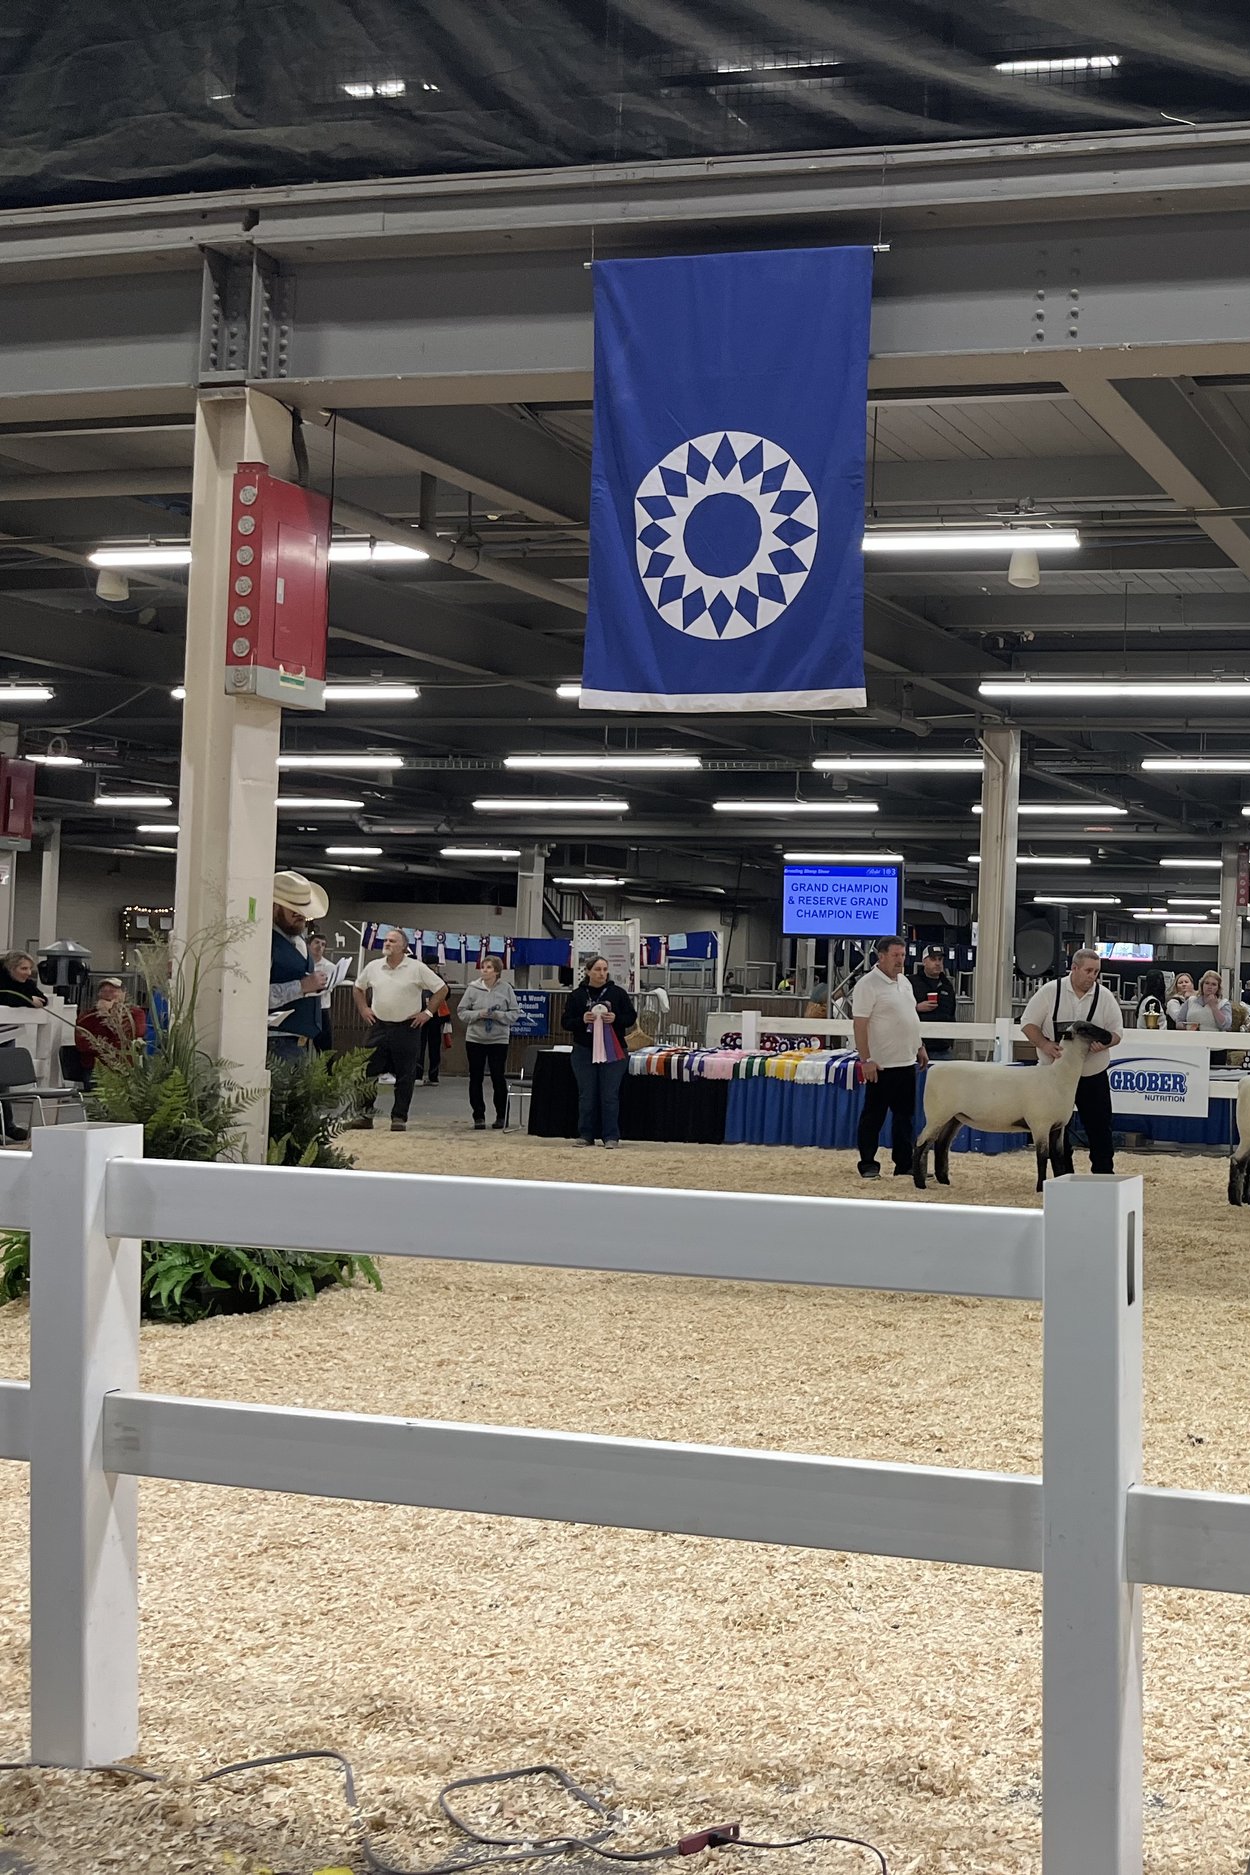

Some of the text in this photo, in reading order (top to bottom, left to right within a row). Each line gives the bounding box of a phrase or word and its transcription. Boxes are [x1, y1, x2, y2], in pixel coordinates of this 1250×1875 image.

[791, 882, 888, 893] GRAND CHAMPION
[787, 896, 889, 907] & RESERVE GRAND
[796, 909, 880, 920] CHAMPION EWE
[1109, 1070, 1187, 1094] GROBER
[1144, 1094, 1185, 1103] NUTRITION
